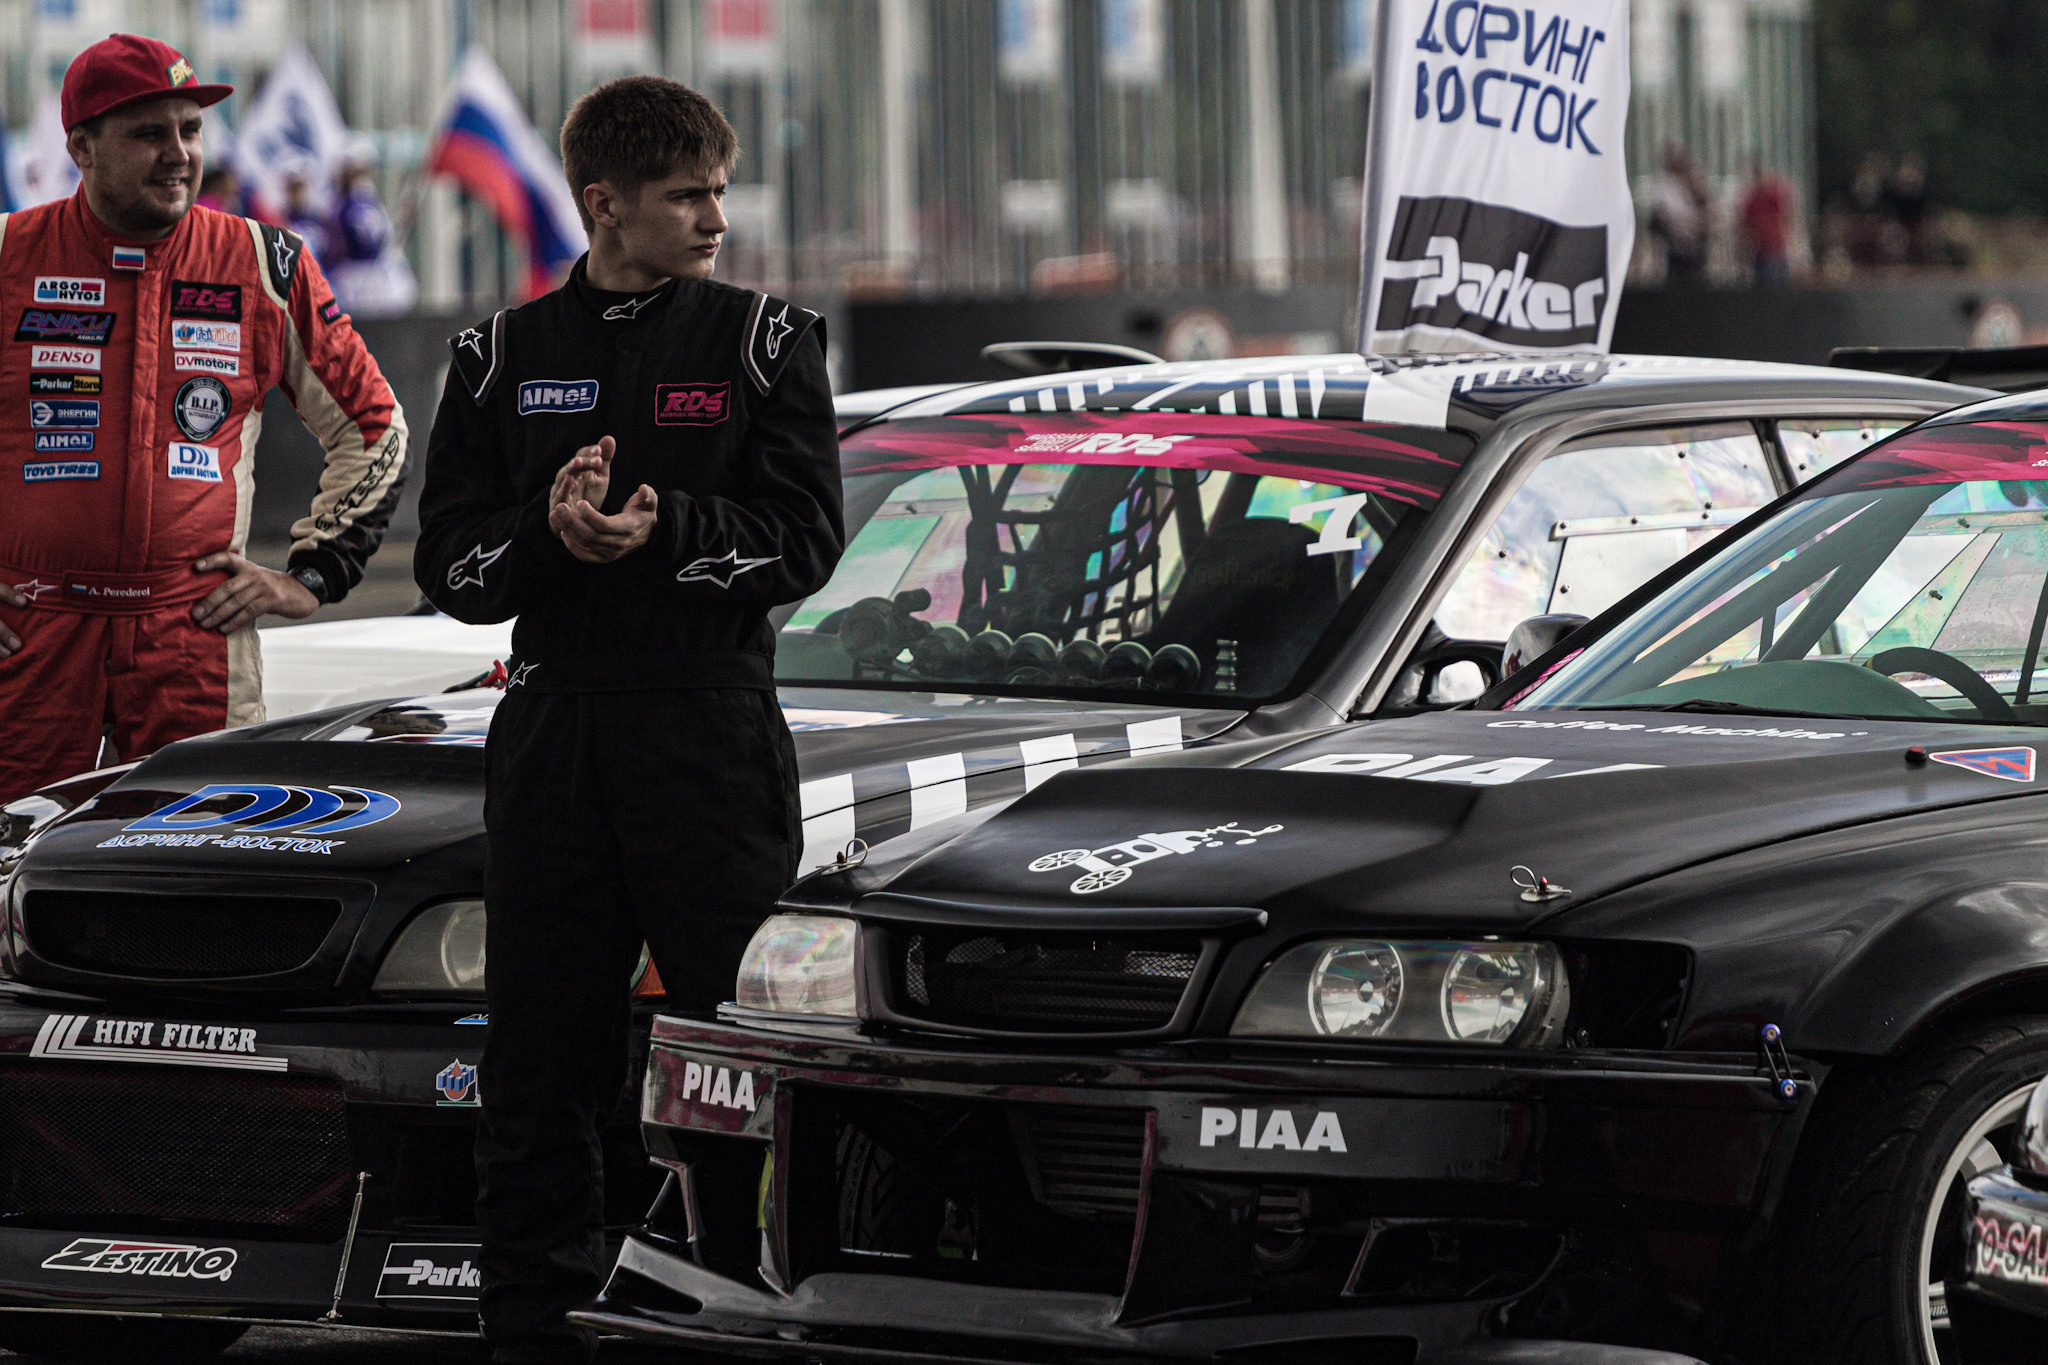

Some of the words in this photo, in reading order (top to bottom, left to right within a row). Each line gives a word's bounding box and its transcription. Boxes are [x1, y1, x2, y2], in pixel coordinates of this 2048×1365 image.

[1415, 61, 1603, 155] ВОСТОК
[39, 281, 79, 290] ARGO
[1385, 236, 1604, 331] Parker
[59, 291, 101, 301] HYTOS
[178, 287, 238, 309] RDS
[21, 311, 112, 330] ANIKU
[38, 350, 95, 364] DENSO
[176, 356, 236, 371] DVmotors
[39, 378, 72, 389] Parker
[74, 379, 99, 389] Store
[523, 386, 591, 408] AIMOL
[663, 390, 727, 412] RDS
[57, 409, 97, 419] ЭНЕРГИЯ
[37, 435, 91, 448] AIMOL
[1066, 433, 1195, 455] RDS
[25, 466, 56, 477] TOYO
[57, 464, 97, 475] TIRES
[1289, 493, 1367, 556] 7
[88, 587, 100, 595] A.
[1486, 720, 1645, 731] Coffee
[1645, 724, 1845, 740] Machine
[97, 833, 346, 855] ДОРИНГ-ВОСТОК
[93, 1019, 154, 1045] HIFI
[160, 1022, 257, 1052] FILTER
[683, 1062, 756, 1112] PIAA
[1199, 1107, 1348, 1153] PIAA
[41, 1237, 237, 1281] ZESTINO
